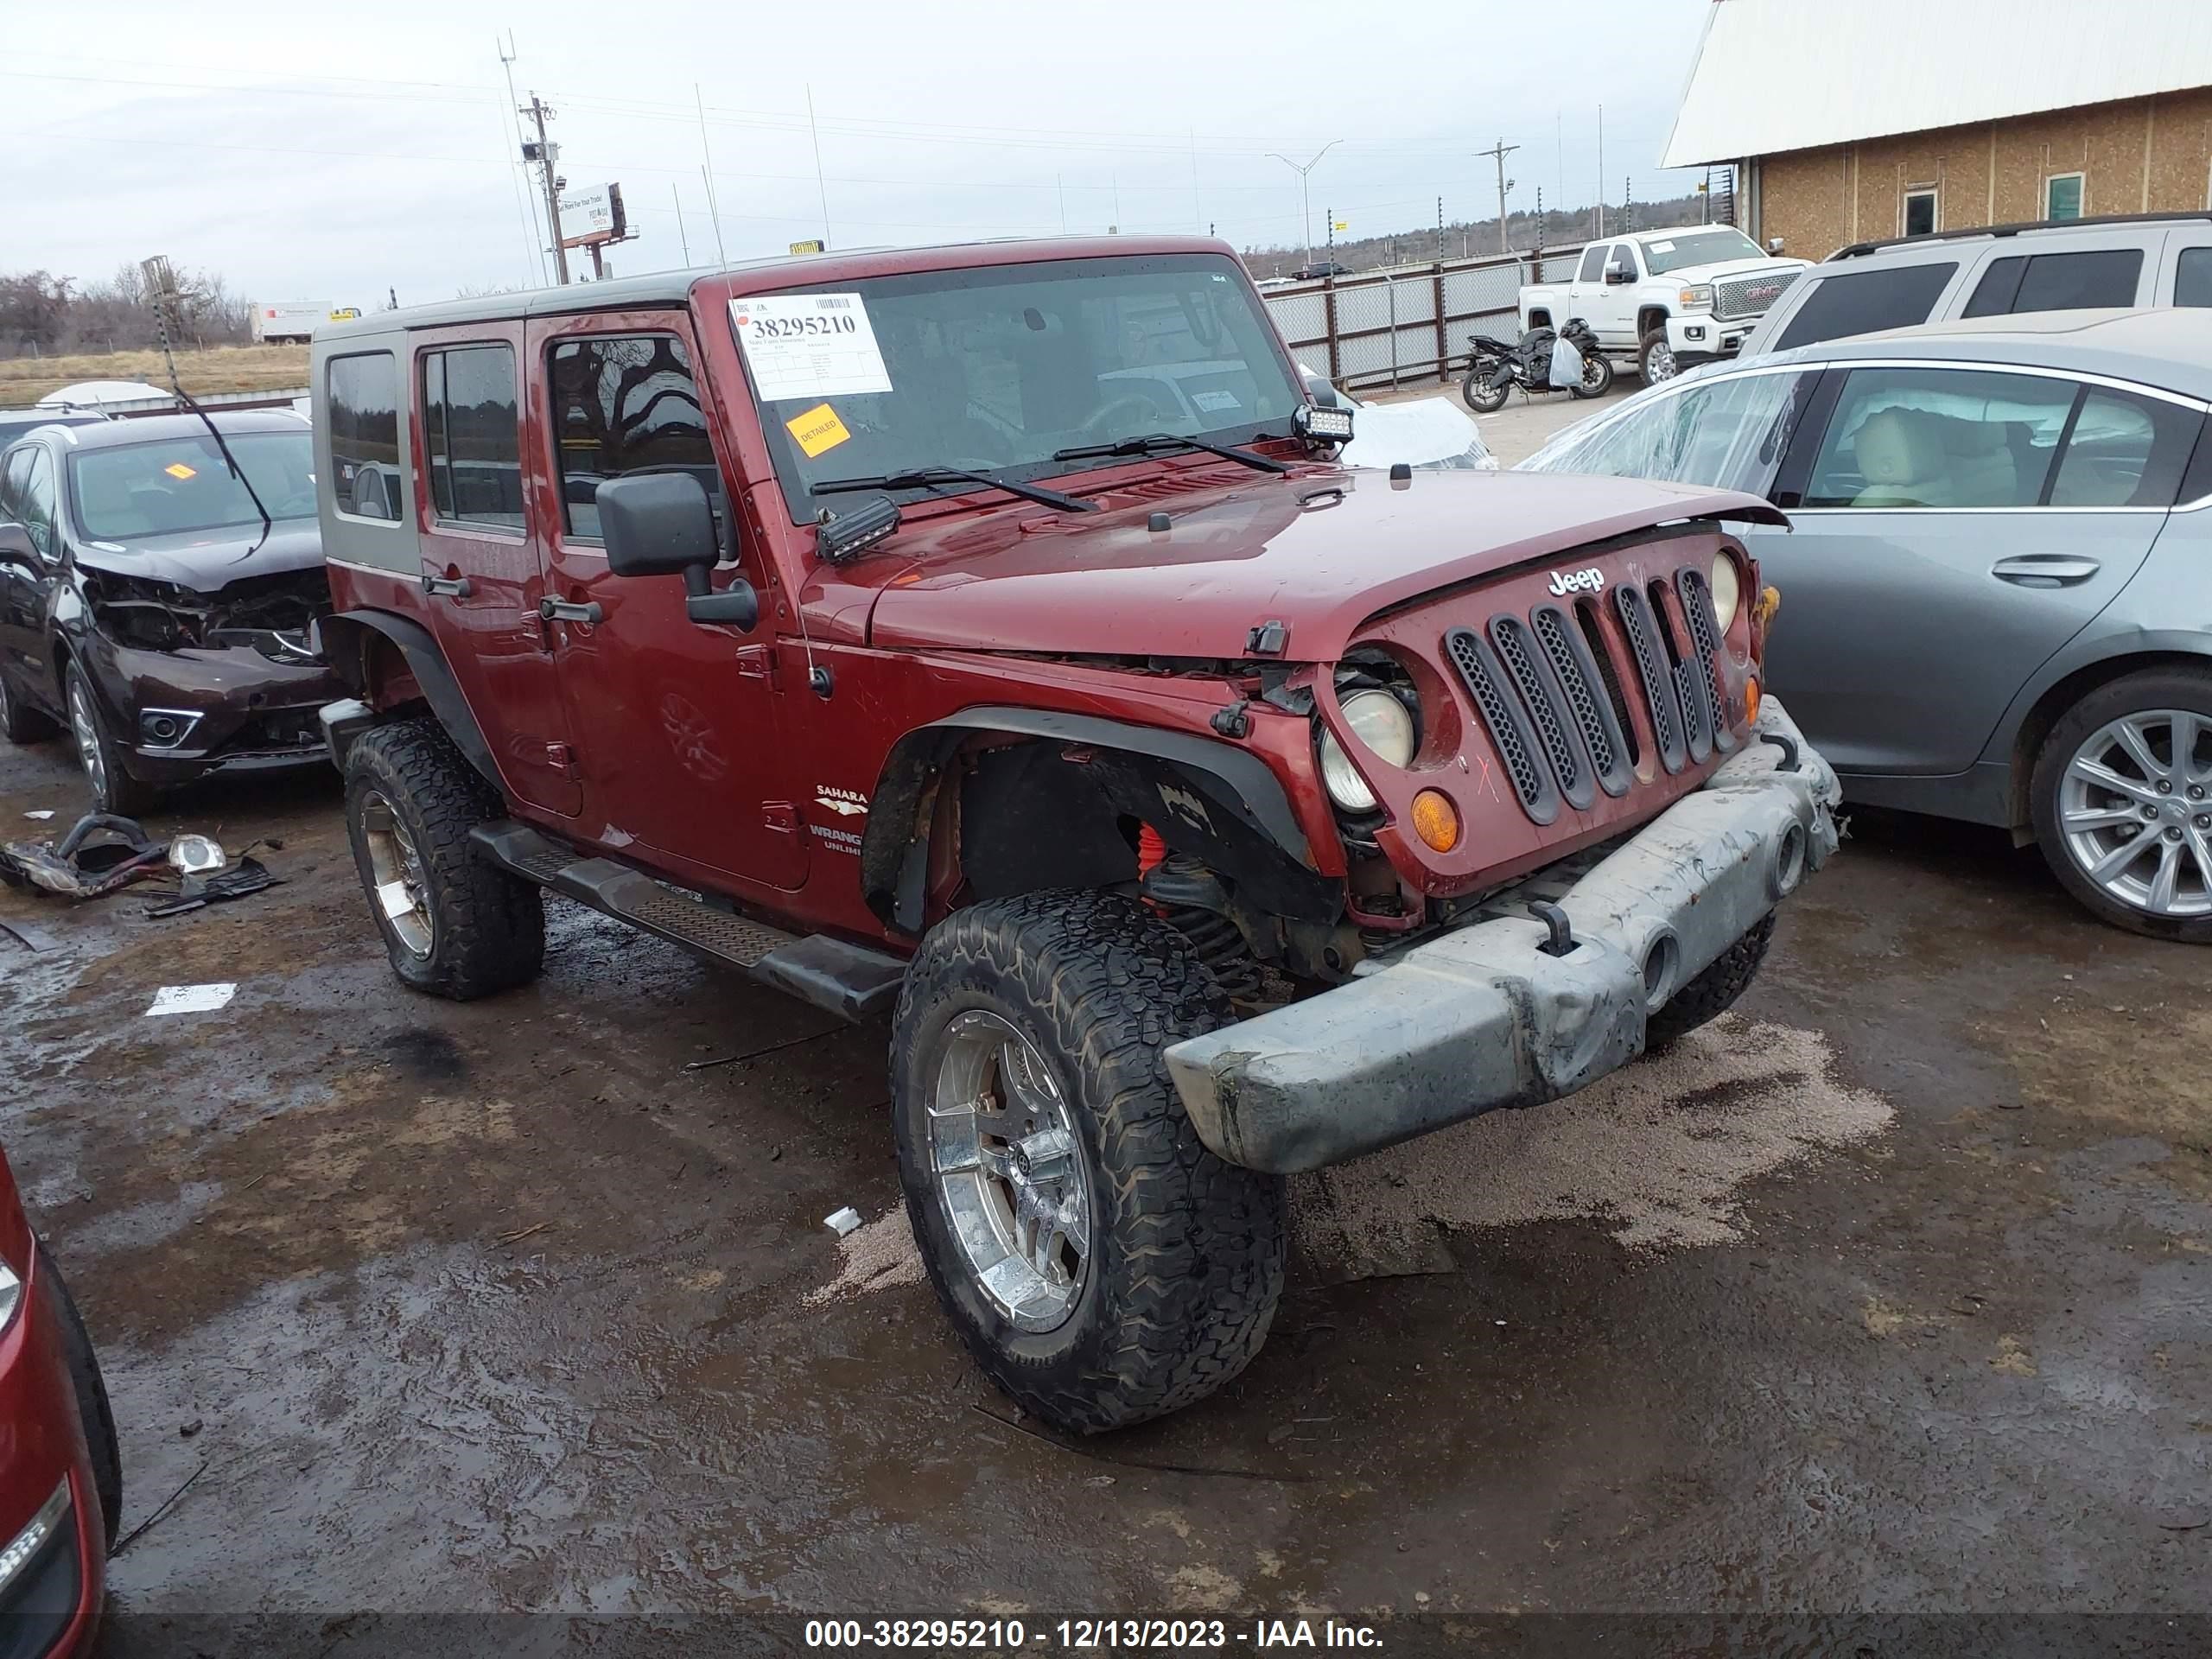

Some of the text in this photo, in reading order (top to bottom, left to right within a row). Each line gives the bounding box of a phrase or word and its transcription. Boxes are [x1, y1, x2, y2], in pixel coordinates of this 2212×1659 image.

[751, 315, 855, 338] 38295210
[801, 420, 836, 442] DETAILED
[1548, 568, 1605, 596] Jeep
[817, 785, 868, 804] SAHARA
[810, 824, 862, 846] WRANG
